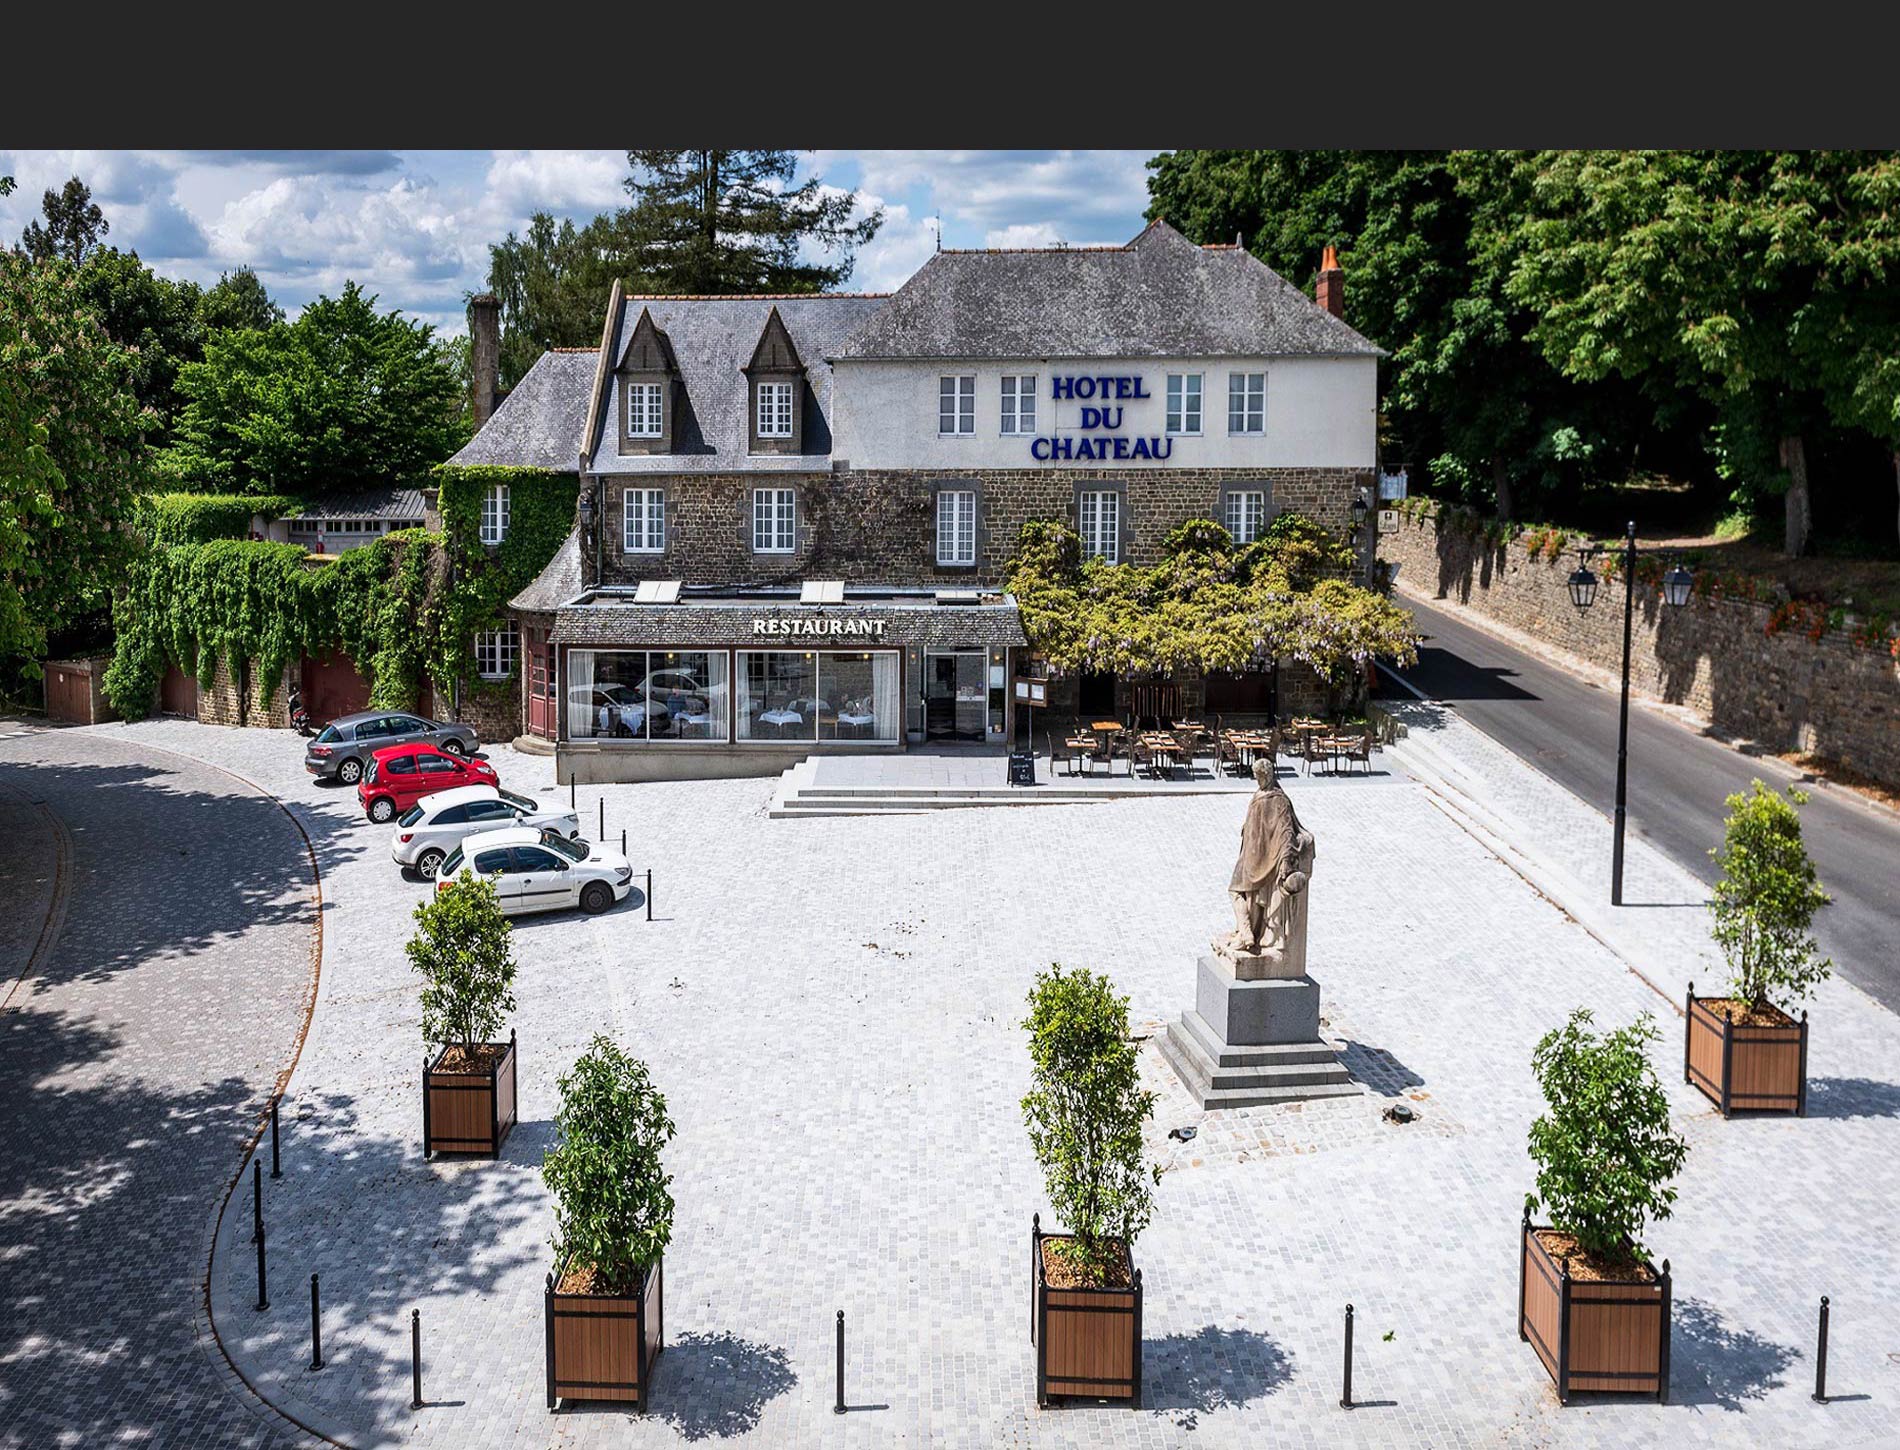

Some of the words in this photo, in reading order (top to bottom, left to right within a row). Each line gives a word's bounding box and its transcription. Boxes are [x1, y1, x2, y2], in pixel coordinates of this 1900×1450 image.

[1052, 376, 1151, 399] HOTEL
[1080, 407, 1123, 429] DU
[1031, 437, 1173, 460] CHATEAU
[753, 619, 886, 635] RESTAURANT
